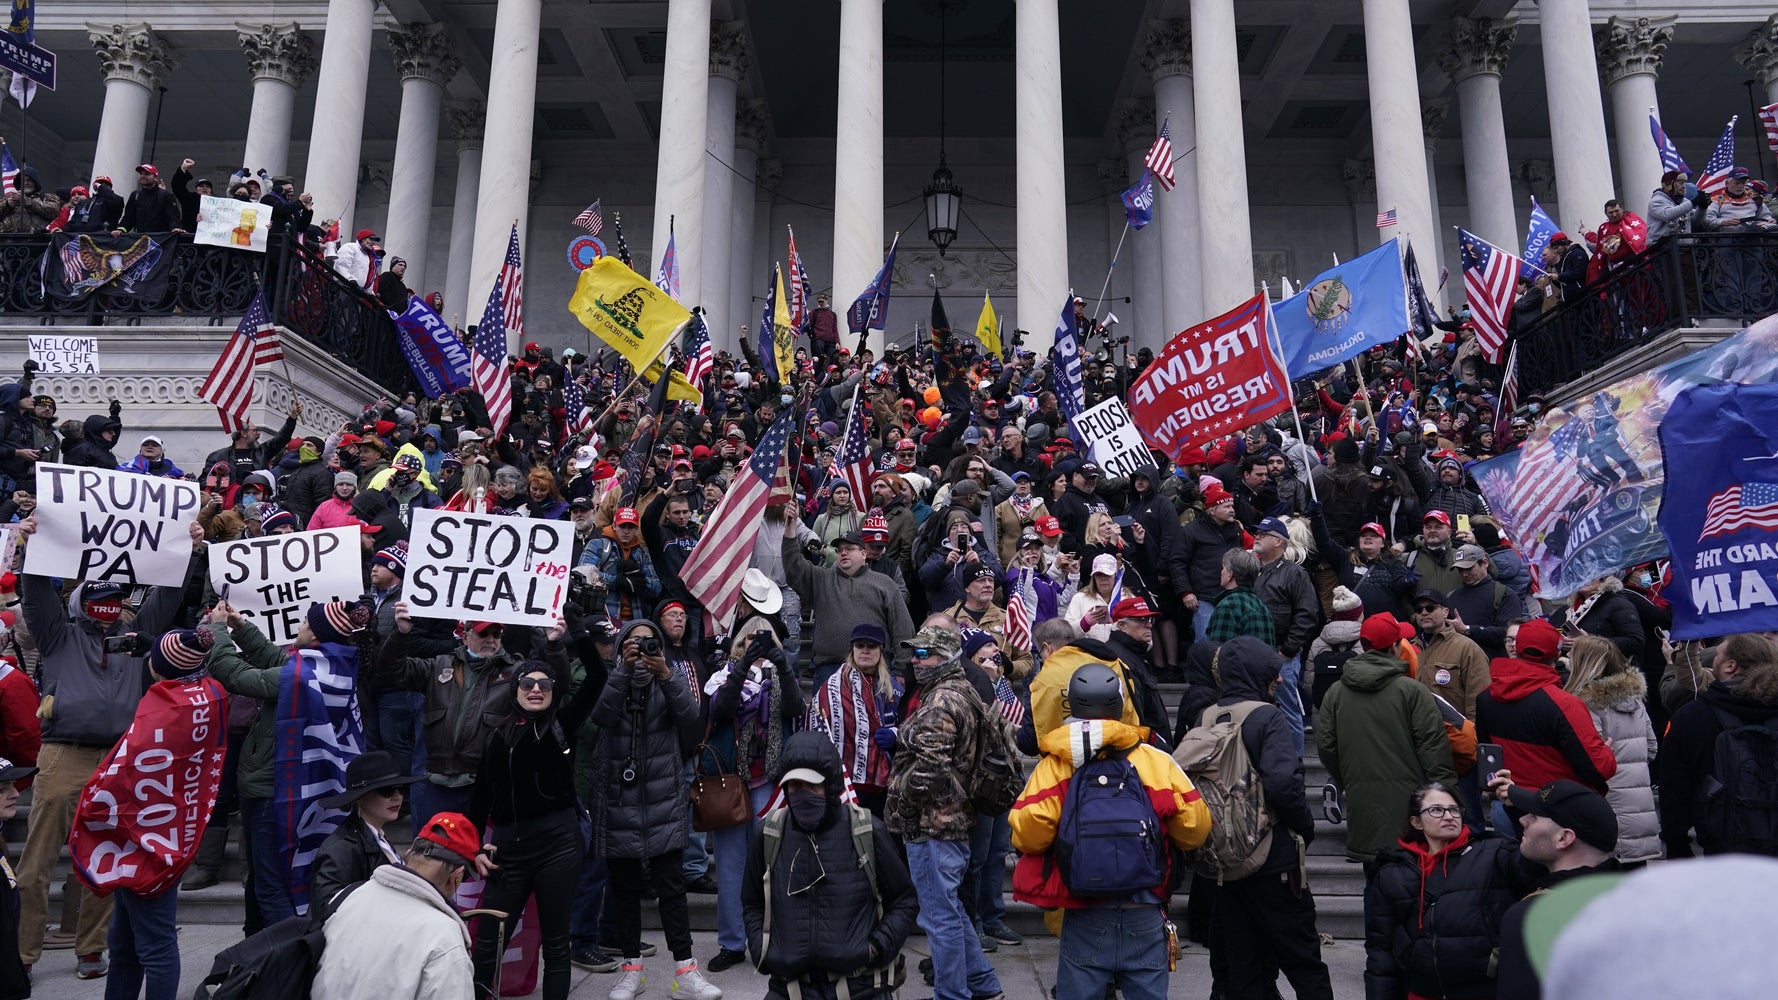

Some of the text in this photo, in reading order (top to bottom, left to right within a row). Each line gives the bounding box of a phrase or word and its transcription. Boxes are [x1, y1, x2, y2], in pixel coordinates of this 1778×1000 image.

[0, 40, 52, 68] TRUMP
[4, 49, 47, 73] PENCE
[29, 337, 99, 353] WELCOME
[34, 350, 92, 363] TO THE
[408, 301, 472, 378] TRUMP
[1077, 401, 1130, 443] PELOSI
[1104, 442, 1152, 478] SATAN
[1107, 434, 1123, 452] IS
[40, 466, 197, 521] TRUMP
[80, 511, 163, 551] WON
[426, 516, 567, 579] STOP the
[77, 548, 137, 584] PA
[224, 532, 339, 584] STOP
[256, 578, 310, 605] THE
[409, 564, 561, 619] STEAL!
[857, 729, 869, 750] But
[853, 752, 867, 782] They
